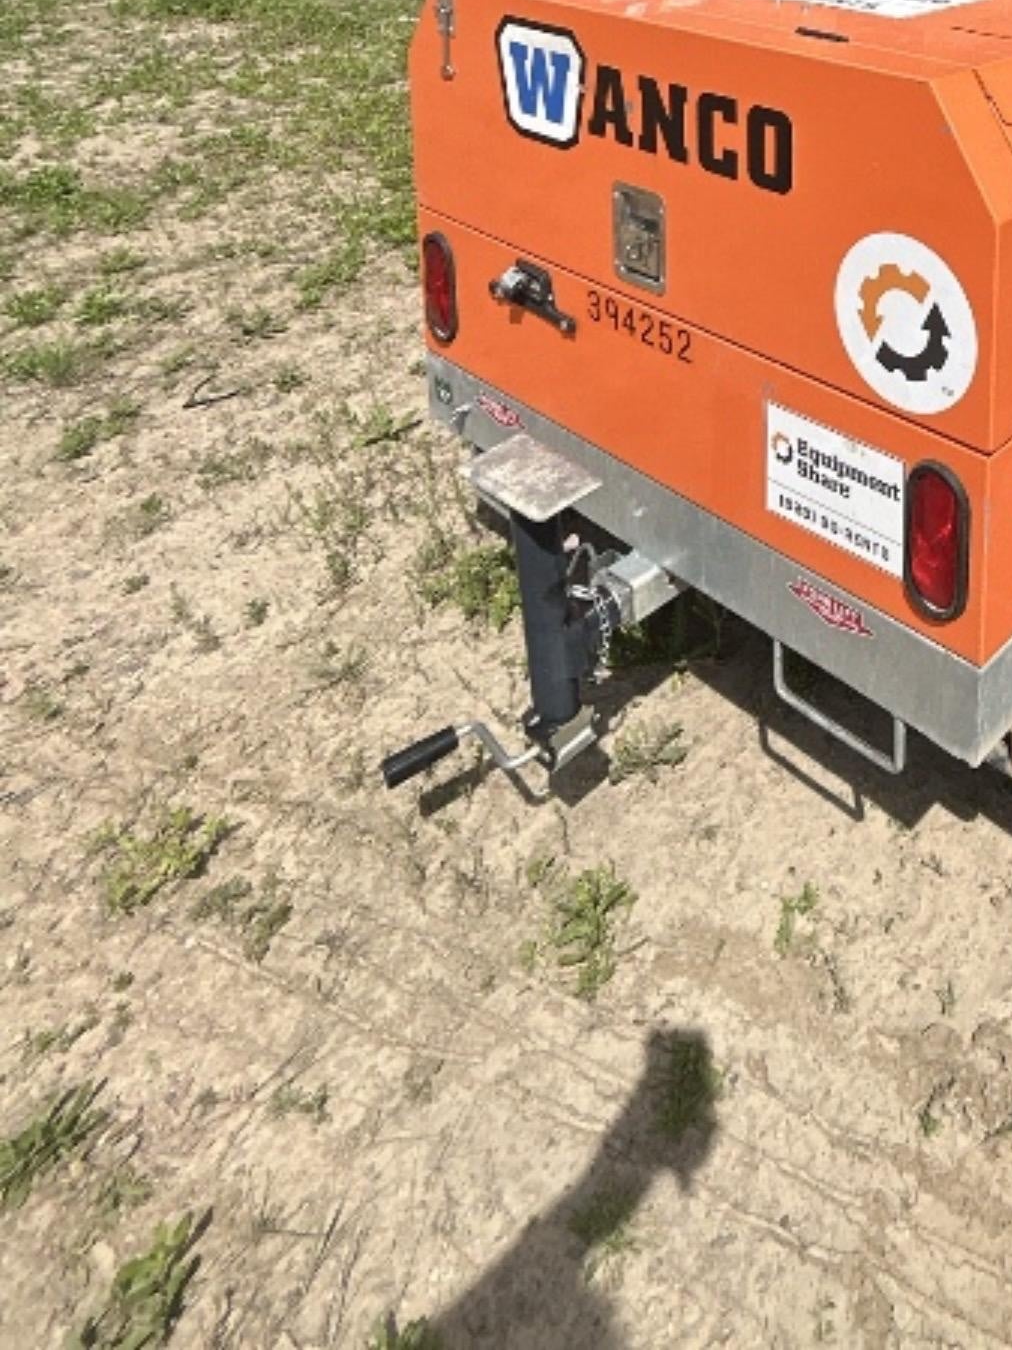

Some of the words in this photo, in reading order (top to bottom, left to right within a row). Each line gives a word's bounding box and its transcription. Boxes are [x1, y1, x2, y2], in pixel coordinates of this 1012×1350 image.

[509, 40, 794, 196] WANCO
[587, 290, 693, 364] 394252
[797, 437, 901, 502] Equipment
[797, 457, 851, 499] Share
